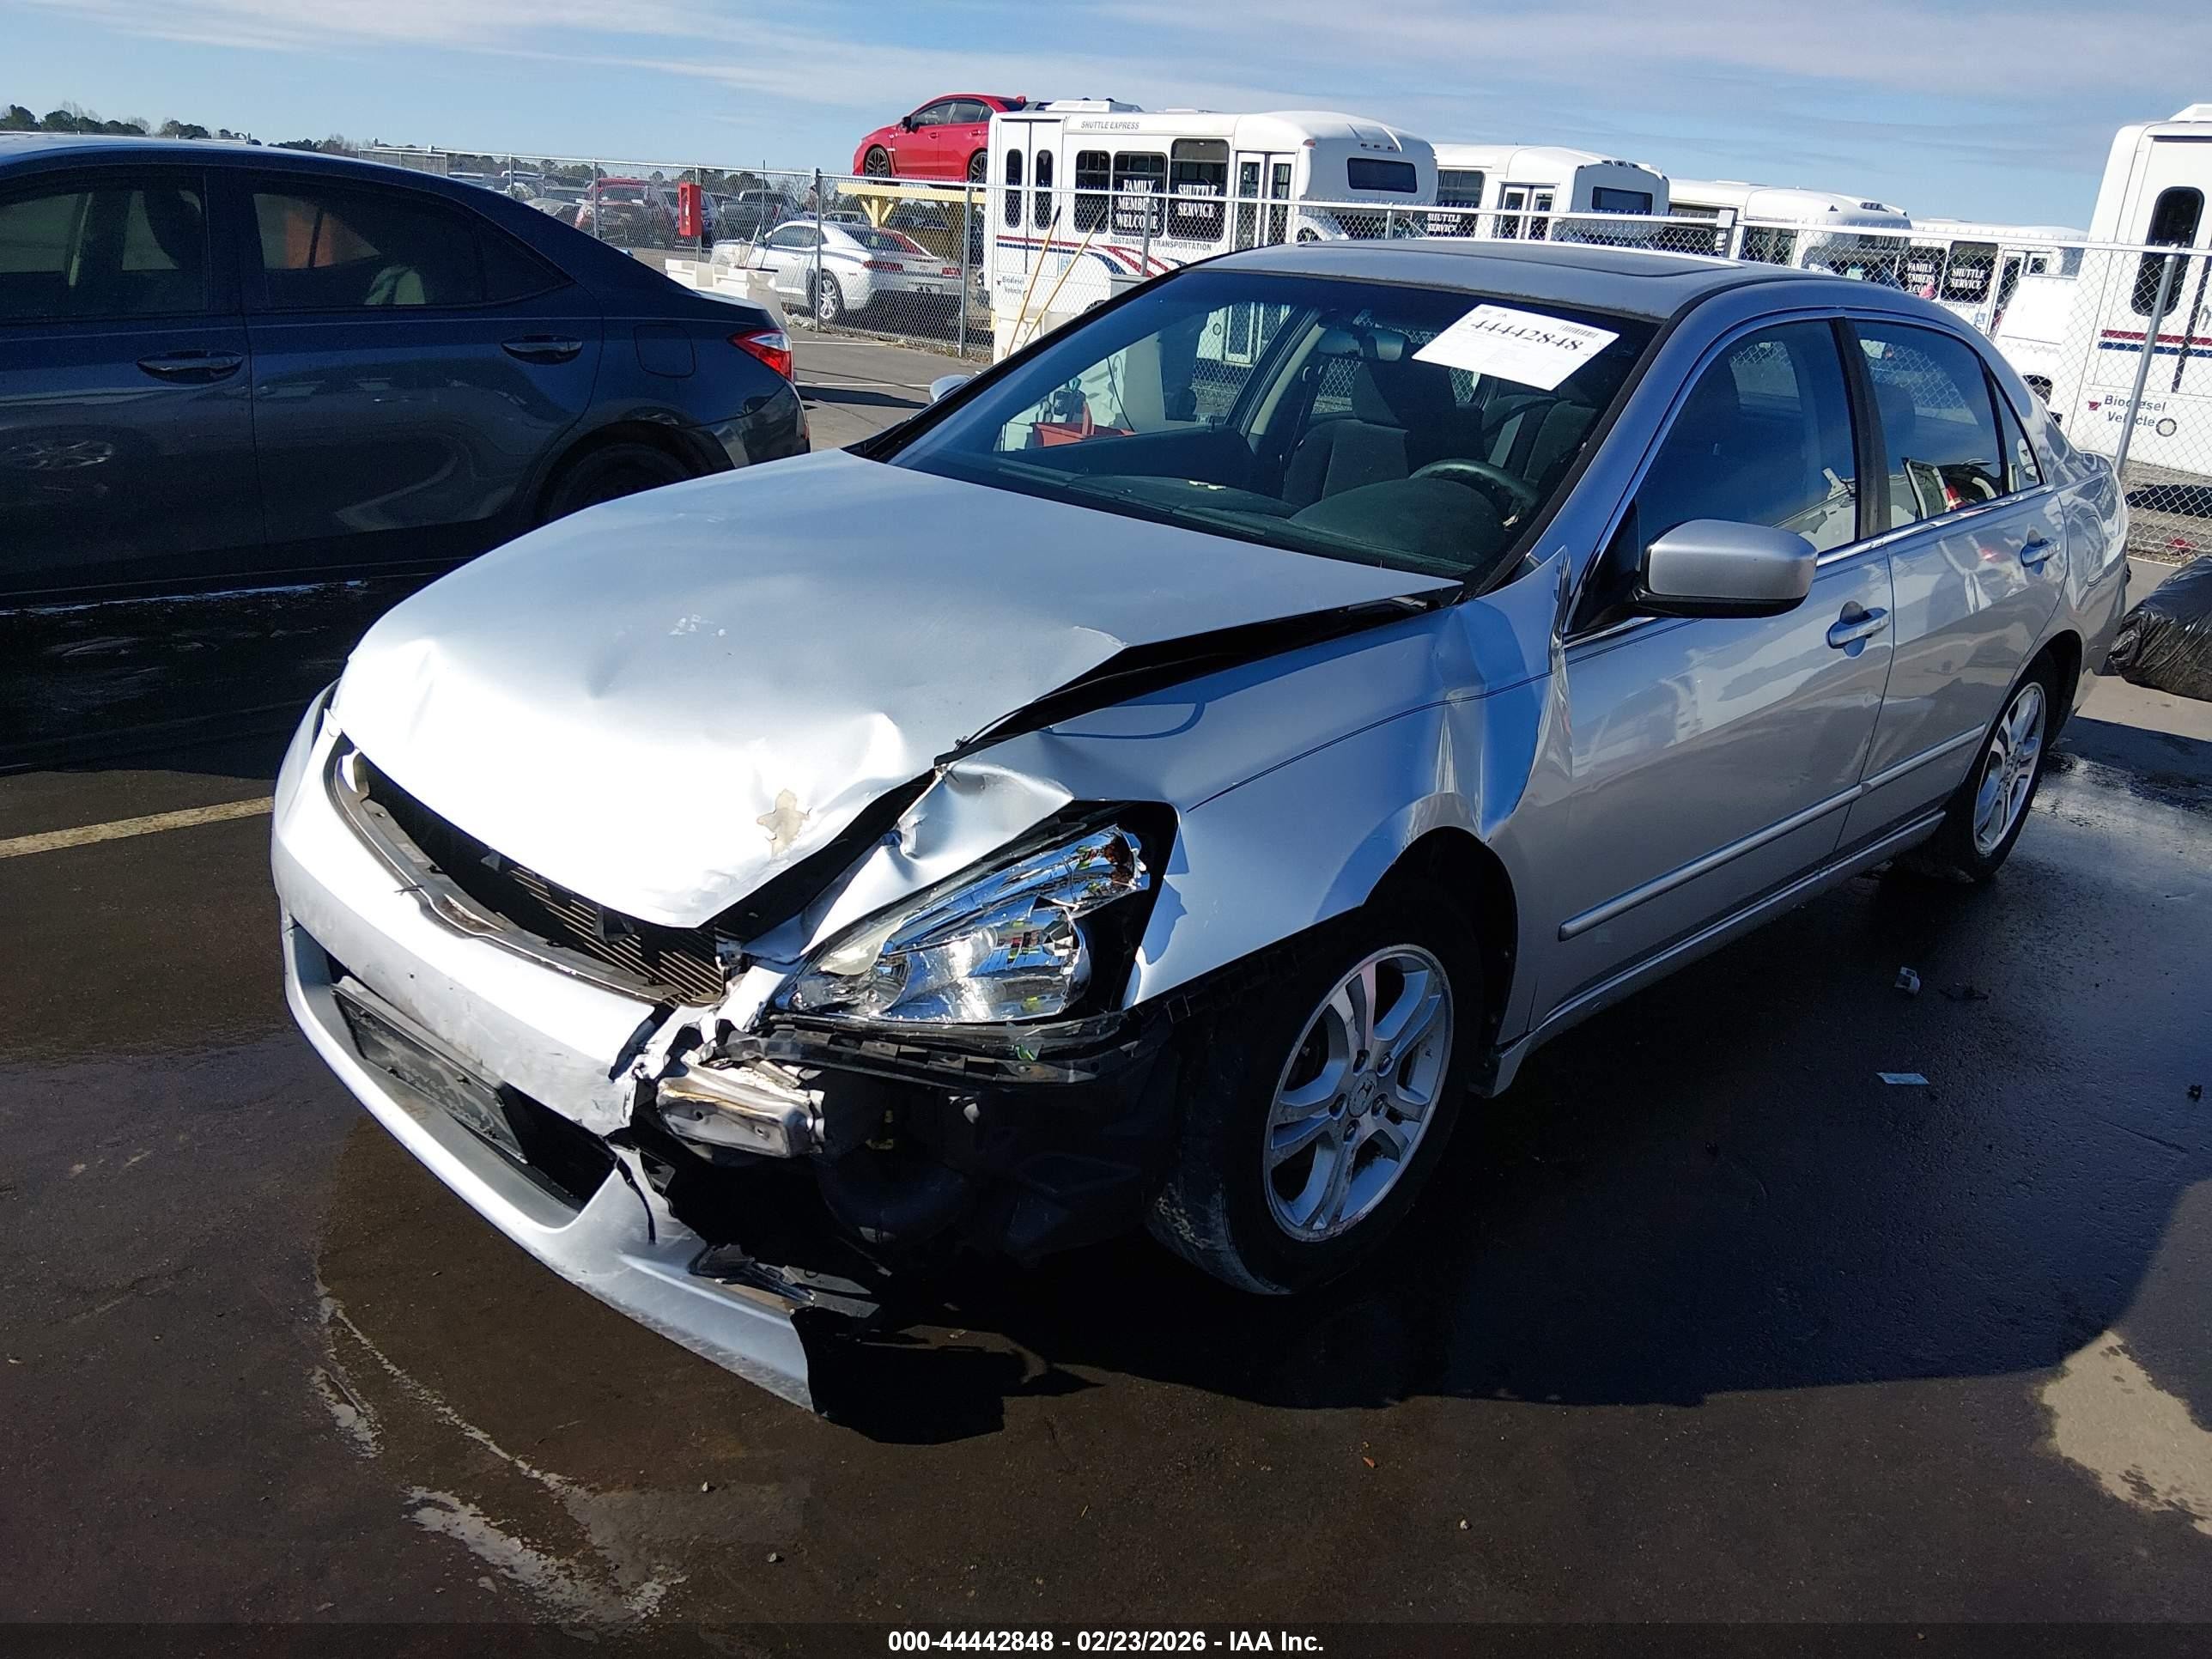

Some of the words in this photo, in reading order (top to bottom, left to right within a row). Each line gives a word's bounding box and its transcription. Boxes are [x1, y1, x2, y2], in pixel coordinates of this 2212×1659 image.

[1080, 120, 1109, 130] SHUTTLE
[1110, 121, 1140, 131] EXPRESS
[1123, 179, 1156, 194] FAMILY
[1177, 184, 1218, 197] SHUTTLE
[1117, 196, 1158, 212] MEMBES
[1177, 202, 1215, 218] SERVICE
[1115, 213, 1158, 229] WELCOE
[1426, 212, 1462, 222] SHUTTLE
[1426, 223, 1458, 233] SERVICE
[1110, 235, 1150, 247] SUSTAINAB
[1153, 239, 1212, 251] TRANSPORTATION
[1906, 262, 1933, 273] FAMILY
[1951, 267, 1986, 279] SHUTTLE
[1950, 278, 1983, 289] SERVICE
[1470, 319, 1584, 352] 44442848
[2104, 394, 2167, 412] Bioesel
